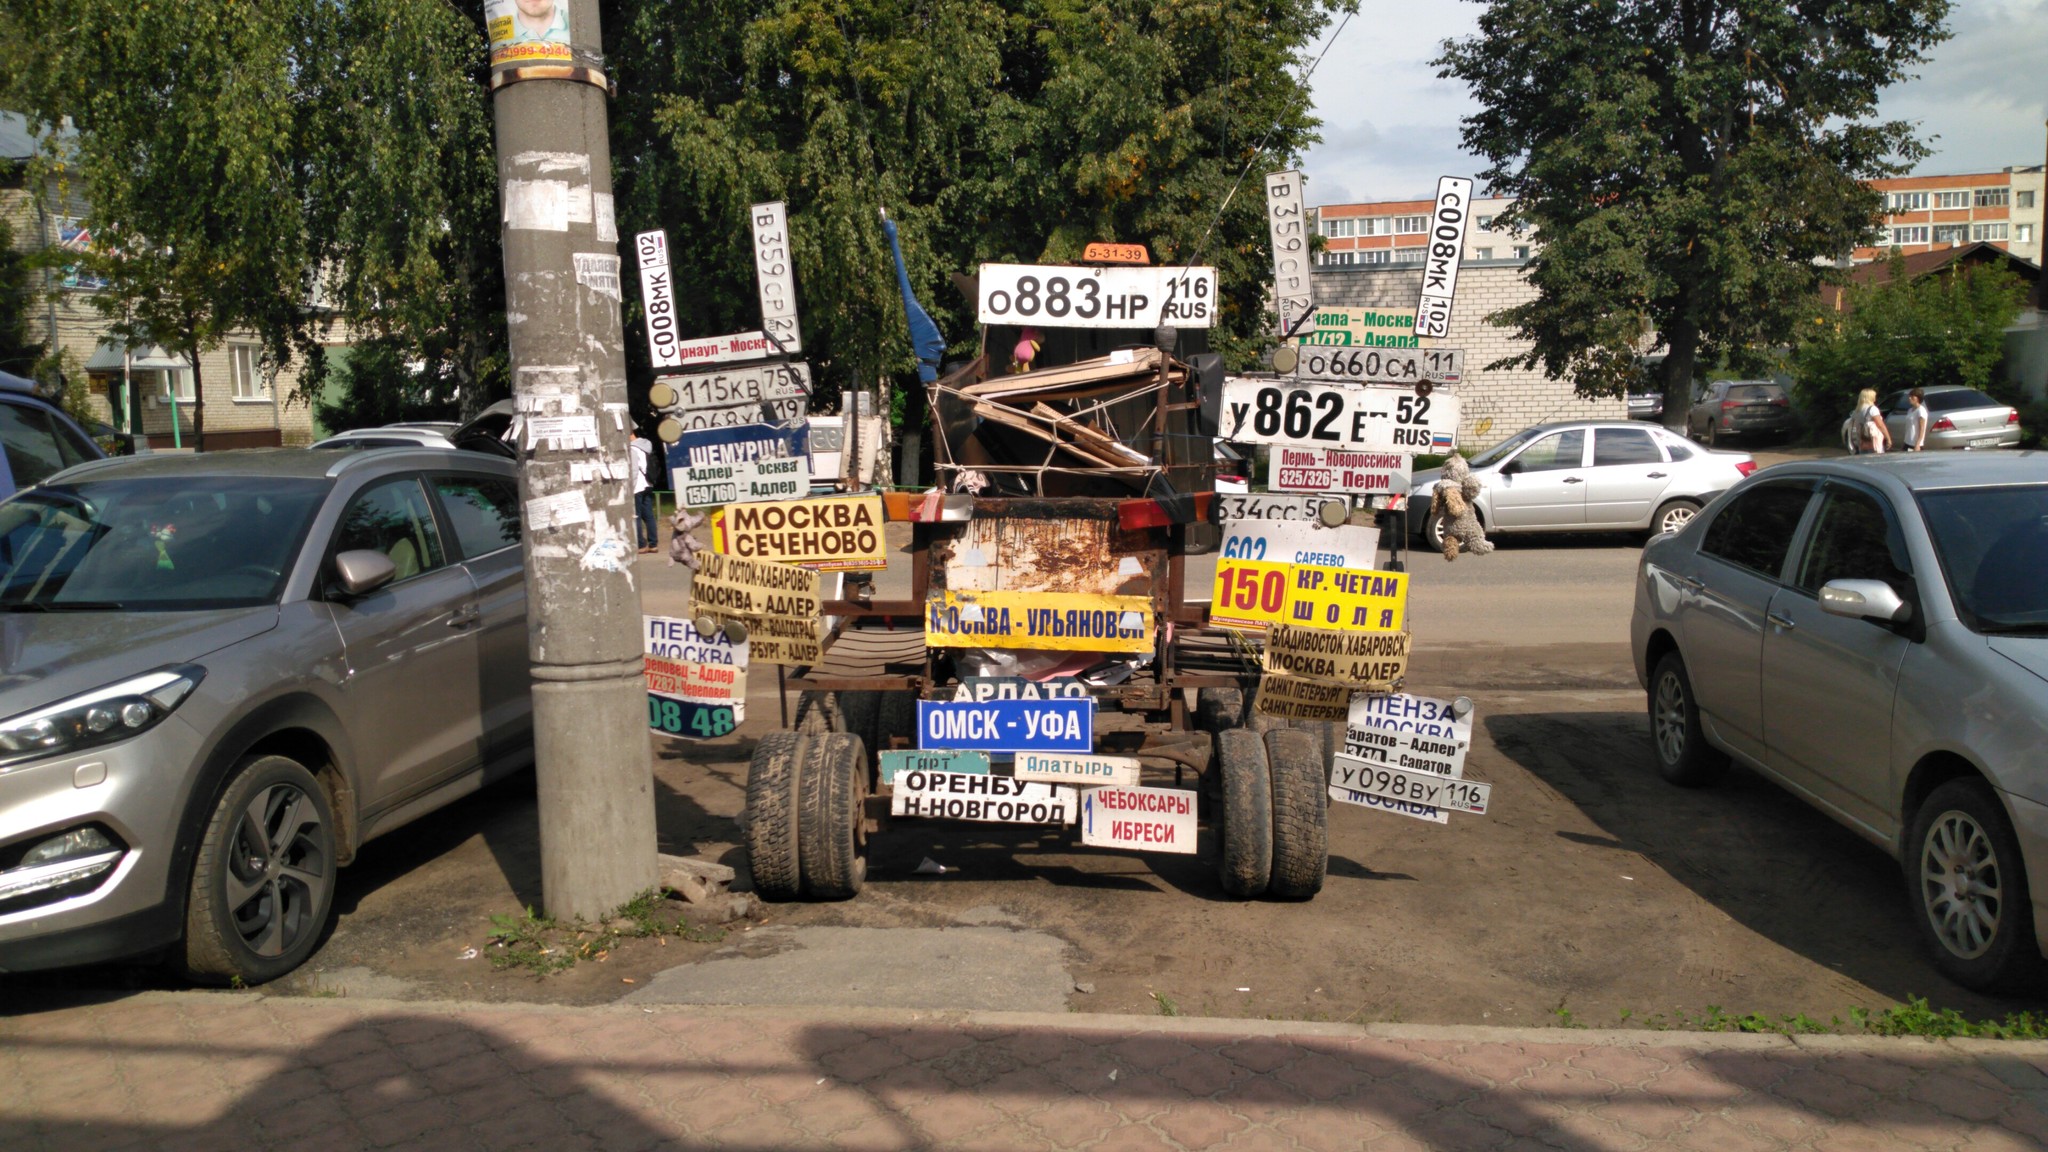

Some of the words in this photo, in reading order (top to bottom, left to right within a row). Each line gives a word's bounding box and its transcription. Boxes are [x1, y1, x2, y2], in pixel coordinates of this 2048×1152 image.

[640, 234, 656, 266] 102
[1089, 248, 1142, 260] 5-31-39
[1166, 277, 1208, 299] 116
[1165, 303, 1207, 319] RUS
[1364, 312, 1415, 327] Москв
[1428, 300, 1448, 334] 102
[1428, 353, 1454, 371] 11
[1425, 371, 1444, 380] RUS
[776, 400, 798, 418] 19
[1396, 396, 1430, 425] 52
[1393, 428, 1431, 446] RUS
[689, 438, 790, 466] ШЕМУРША
[1282, 448, 1315, 466] Пермь
[689, 466, 733, 481] Адлер
[1281, 469, 1330, 487] 325/326
[687, 484, 735, 504] 159/160
[751, 481, 797, 496] Адлер
[734, 504, 874, 530] МОСКВА
[736, 530, 877, 557] СЕЧЕНОВО
[1224, 535, 1267, 561] 602
[1295, 551, 1345, 567] САРЕЕВО
[1218, 567, 1286, 613] 150
[1297, 569, 1328, 592] КР.
[1334, 573, 1398, 597] ЧЕТАИ
[695, 582, 753, 611] МОСКВА
[766, 595, 815, 617] АДЛЕР
[651, 642, 734, 665] МОСКВА
[788, 643, 819, 661] АДЛЕР
[1272, 627, 1344, 655] ВЛАДИВОСТОК
[1344, 635, 1407, 657] ХАБАРОВСК
[699, 665, 734, 684] Адлер
[1269, 652, 1335, 677] МОСКВА
[1349, 662, 1401, 681] АДЛЕР
[1265, 676, 1294, 695] САНКТ
[1293, 681, 1343, 703] ПЕТЕРБУРГ
[1261, 697, 1294, 715] САНКТ
[1367, 696, 1457, 723] ПЕНЗА
[691, 707, 734, 736] 48
[929, 709, 1000, 740] ОМСК
[1024, 709, 1082, 740] УФА
[1410, 737, 1456, 757] Адлер
[1027, 755, 1113, 776] Алатырь
[1099, 790, 1190, 815] ЧЕБОКСАРЫ
[1445, 783, 1481, 803] 116
[1450, 800, 1470, 809] RUS
[904, 796, 1066, 824] Н-НОВГОРОД
[1084, 794, 1093, 835] 1
[1112, 820, 1174, 843] ИБРЕСИ
